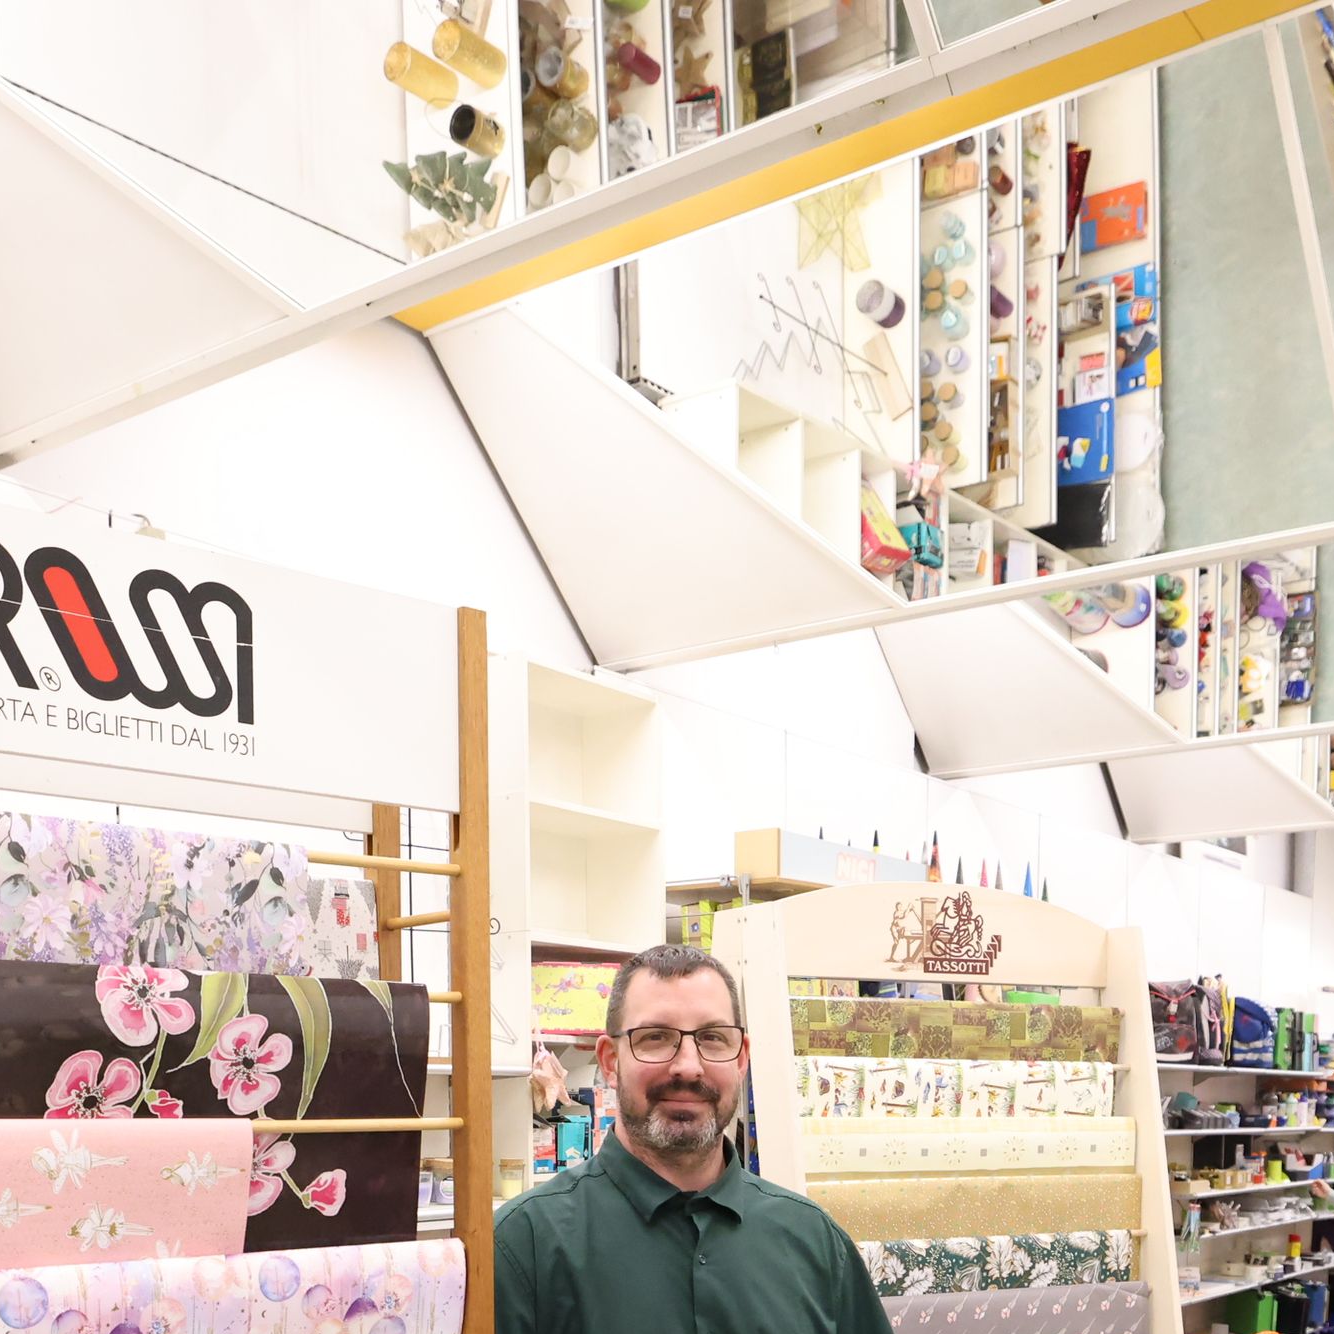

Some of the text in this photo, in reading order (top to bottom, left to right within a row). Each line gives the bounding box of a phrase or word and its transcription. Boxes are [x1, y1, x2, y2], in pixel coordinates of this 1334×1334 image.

[47, 704, 58, 728] E
[67, 707, 164, 744] BIGLIETTI
[171, 724, 214, 751] DAL
[223, 732, 256, 757] 1931
[927, 960, 986, 973] TASSOTTI
